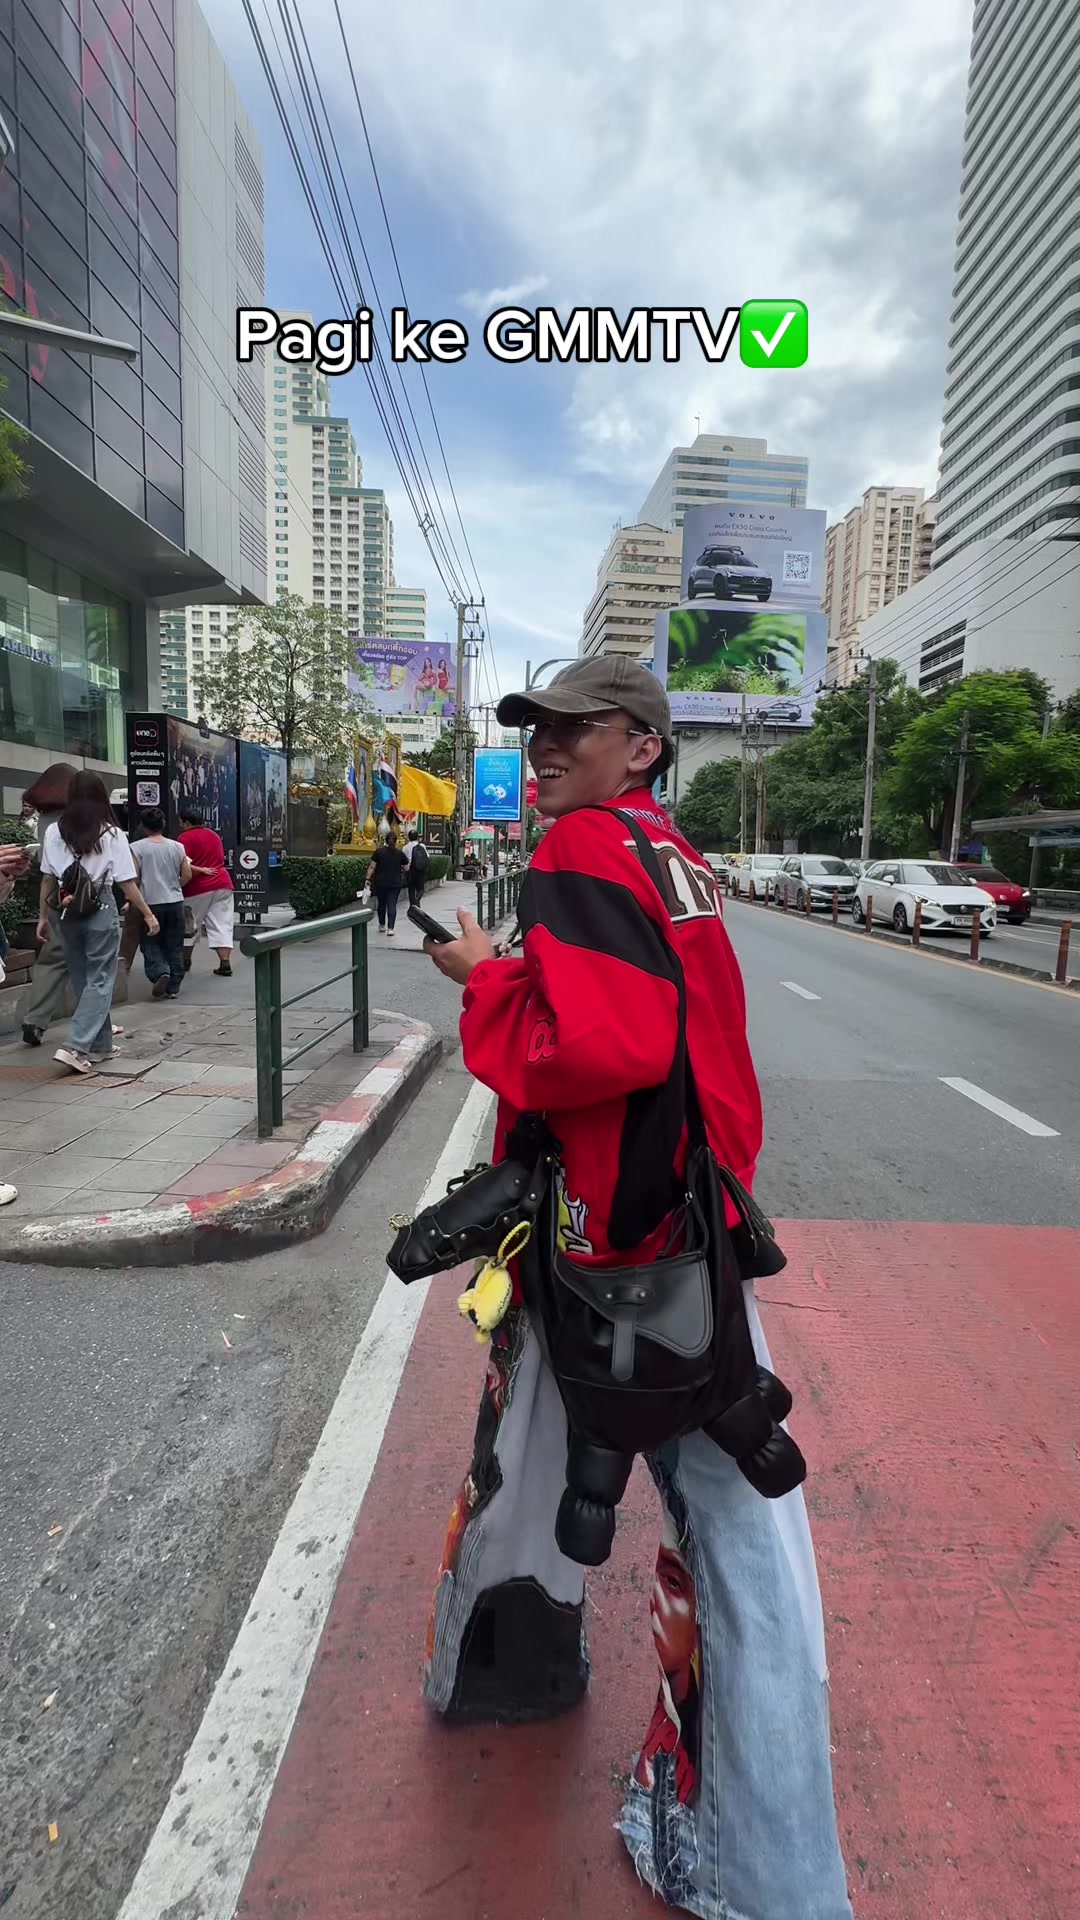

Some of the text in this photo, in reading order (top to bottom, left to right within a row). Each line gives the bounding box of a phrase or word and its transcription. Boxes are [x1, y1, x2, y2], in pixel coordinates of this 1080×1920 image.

[729, 512, 775, 520] VOLVO
[731, 523, 748, 531] EX30
[765, 526, 788, 534] Country
[236, 871, 262, 880] ทางเข้า
[240, 880, 259, 889] อโศก
